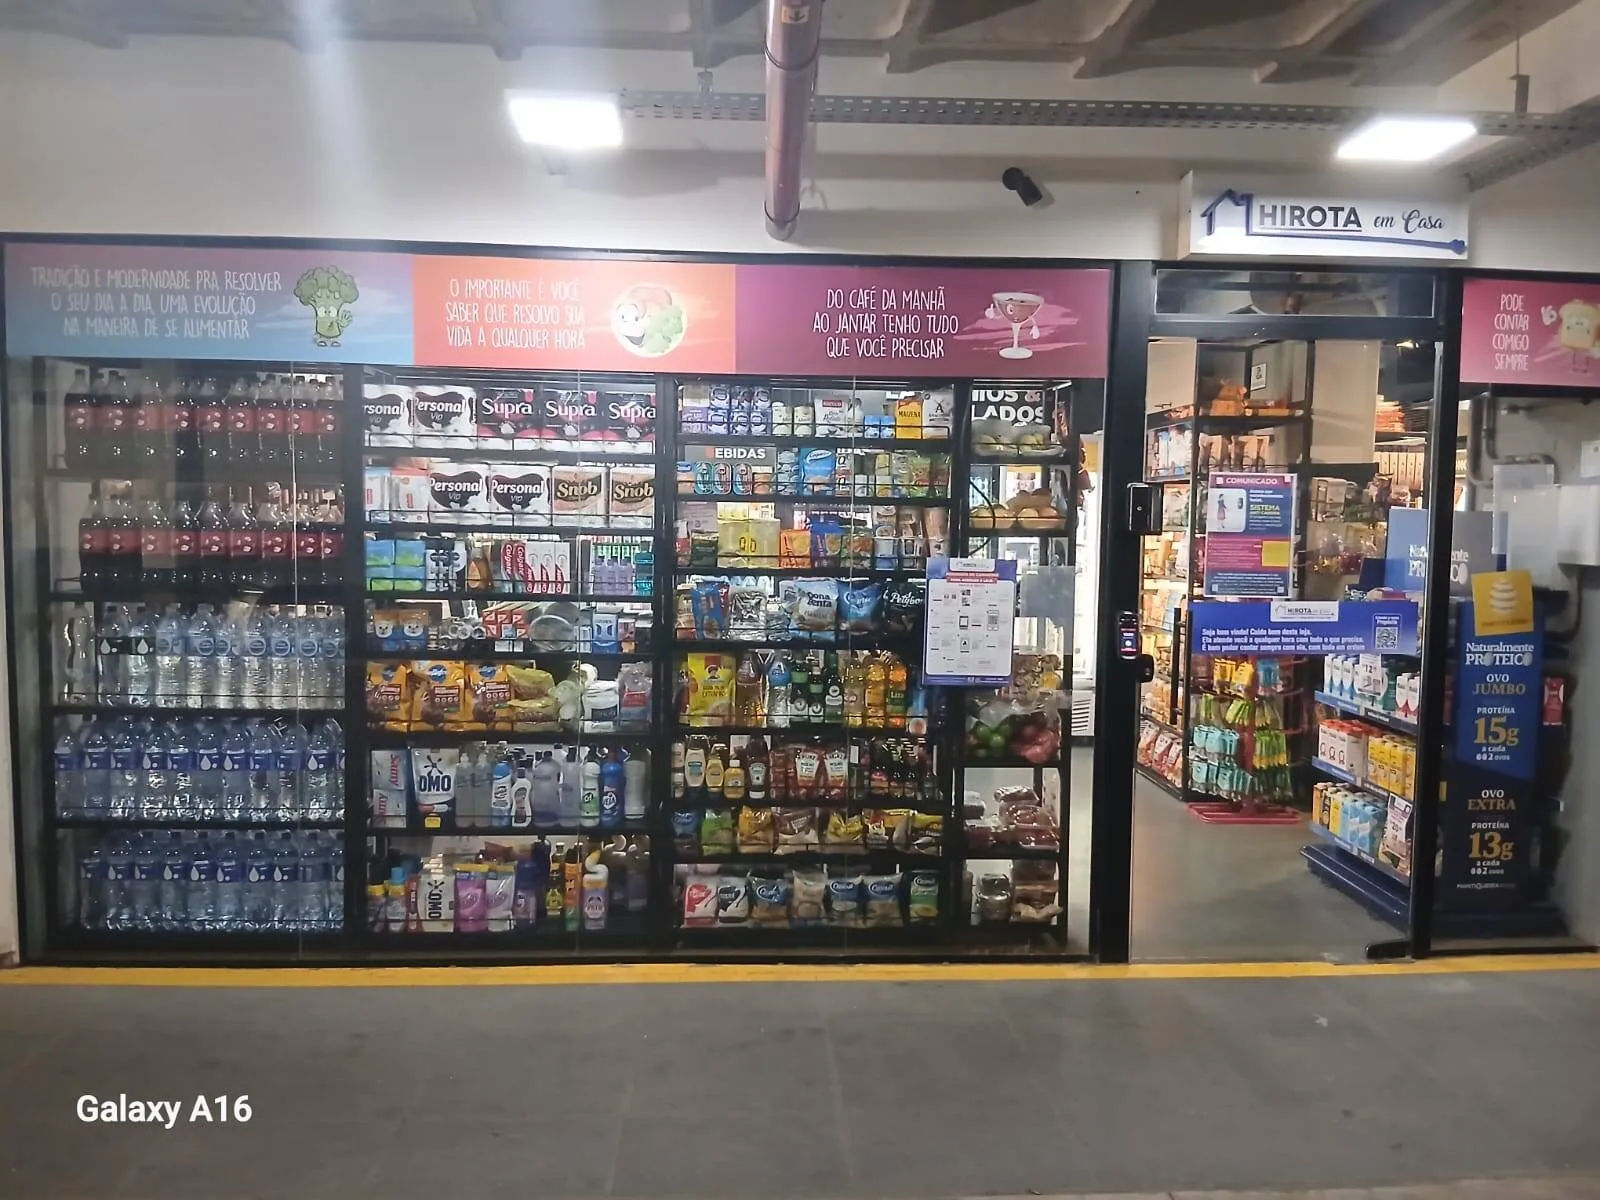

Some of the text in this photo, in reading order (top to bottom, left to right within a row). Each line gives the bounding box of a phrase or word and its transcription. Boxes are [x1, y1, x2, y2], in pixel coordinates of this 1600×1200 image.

[1259, 204, 1444, 234] HIROTA em Casa
[31, 265, 282, 291] TRADIÇÃO E MODERNIDADE PRA RESOLVER
[449, 279, 459, 298] O
[465, 279, 533, 299] IMPORTANTE
[827, 285, 946, 311] DO CAFÉ DA MANHÃ
[51, 292, 61, 312] O
[67, 292, 89, 312] SEU
[95, 292, 114, 313] DIA
[120, 293, 128, 312] A
[161, 294, 189, 314] UMA
[194, 292, 256, 318] EVOLUÇÃO
[1501, 294, 1524, 311] PODE
[445, 302, 585, 324] SABER QUE RESOLVO SUA
[1494, 314, 1530, 331] CONTAR
[63, 316, 249, 339] NA MANEIRA DE SE ALIMENTAR
[813, 313, 959, 335] AO JANTAR TENHO TUDO
[447, 328, 585, 348] VIDA A QUALQUER HORA
[827, 334, 945, 359] QUE VOCÊ PRECISAR
[1492, 333, 1529, 351] COMIGO
[1495, 353, 1529, 371] SEMPRE
[364, 401, 404, 415] rsonal
[482, 398, 532, 419] Supra
[546, 400, 596, 421] Supra
[608, 402, 656, 423] Supra
[708, 448, 766, 459] EBIDAS
[430, 477, 483, 492] Personal
[492, 480, 544, 494] Personal
[557, 481, 597, 497] Snob
[614, 483, 654, 499] Snob
[506, 544, 514, 575] Colgate
[517, 547, 525, 577] Colgate
[1466, 642, 1534, 652] Naturalmente
[1486, 674, 1509, 682] OVO
[1472, 683, 1526, 695] JUMBO
[1477, 705, 1516, 714] PROTEÍNA
[1474, 717, 1519, 746] 15g
[419, 775, 451, 792] OMO
[1481, 789, 1504, 798] OVO
[1467, 799, 1516, 811] EXTRA
[1468, 832, 1514, 860] 13g
[428, 894, 441, 919] OMO
